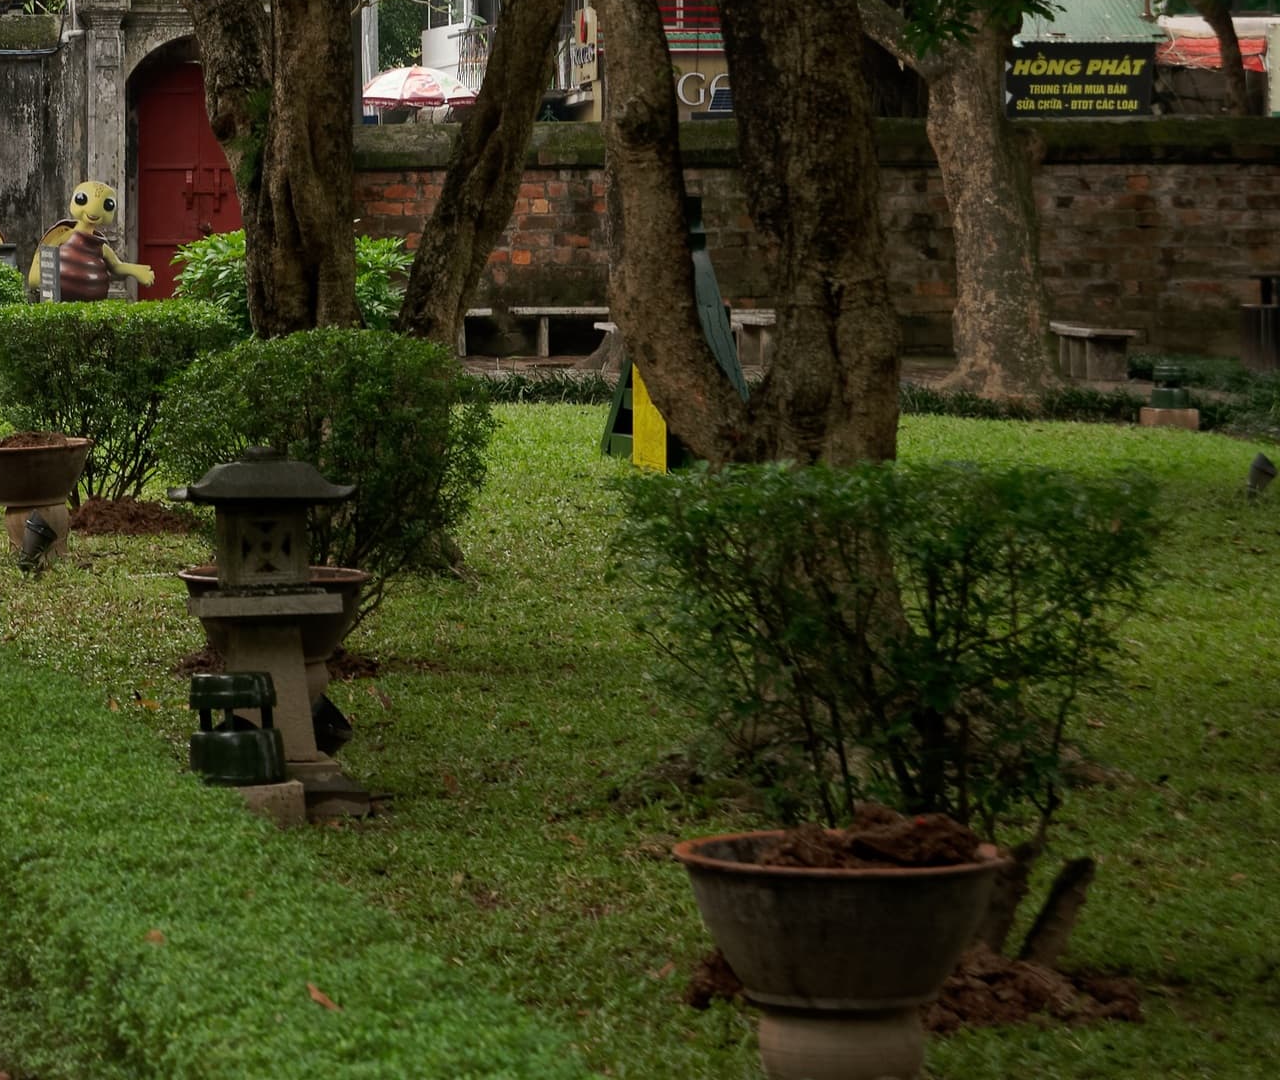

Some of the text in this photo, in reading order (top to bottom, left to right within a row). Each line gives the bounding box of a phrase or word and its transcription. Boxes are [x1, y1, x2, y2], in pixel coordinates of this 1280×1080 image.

[1012, 52, 1146, 76] HỒNG PHÁT
[1029, 84, 1059, 95] TRUNG
[1084, 84, 1105, 95] MUA
